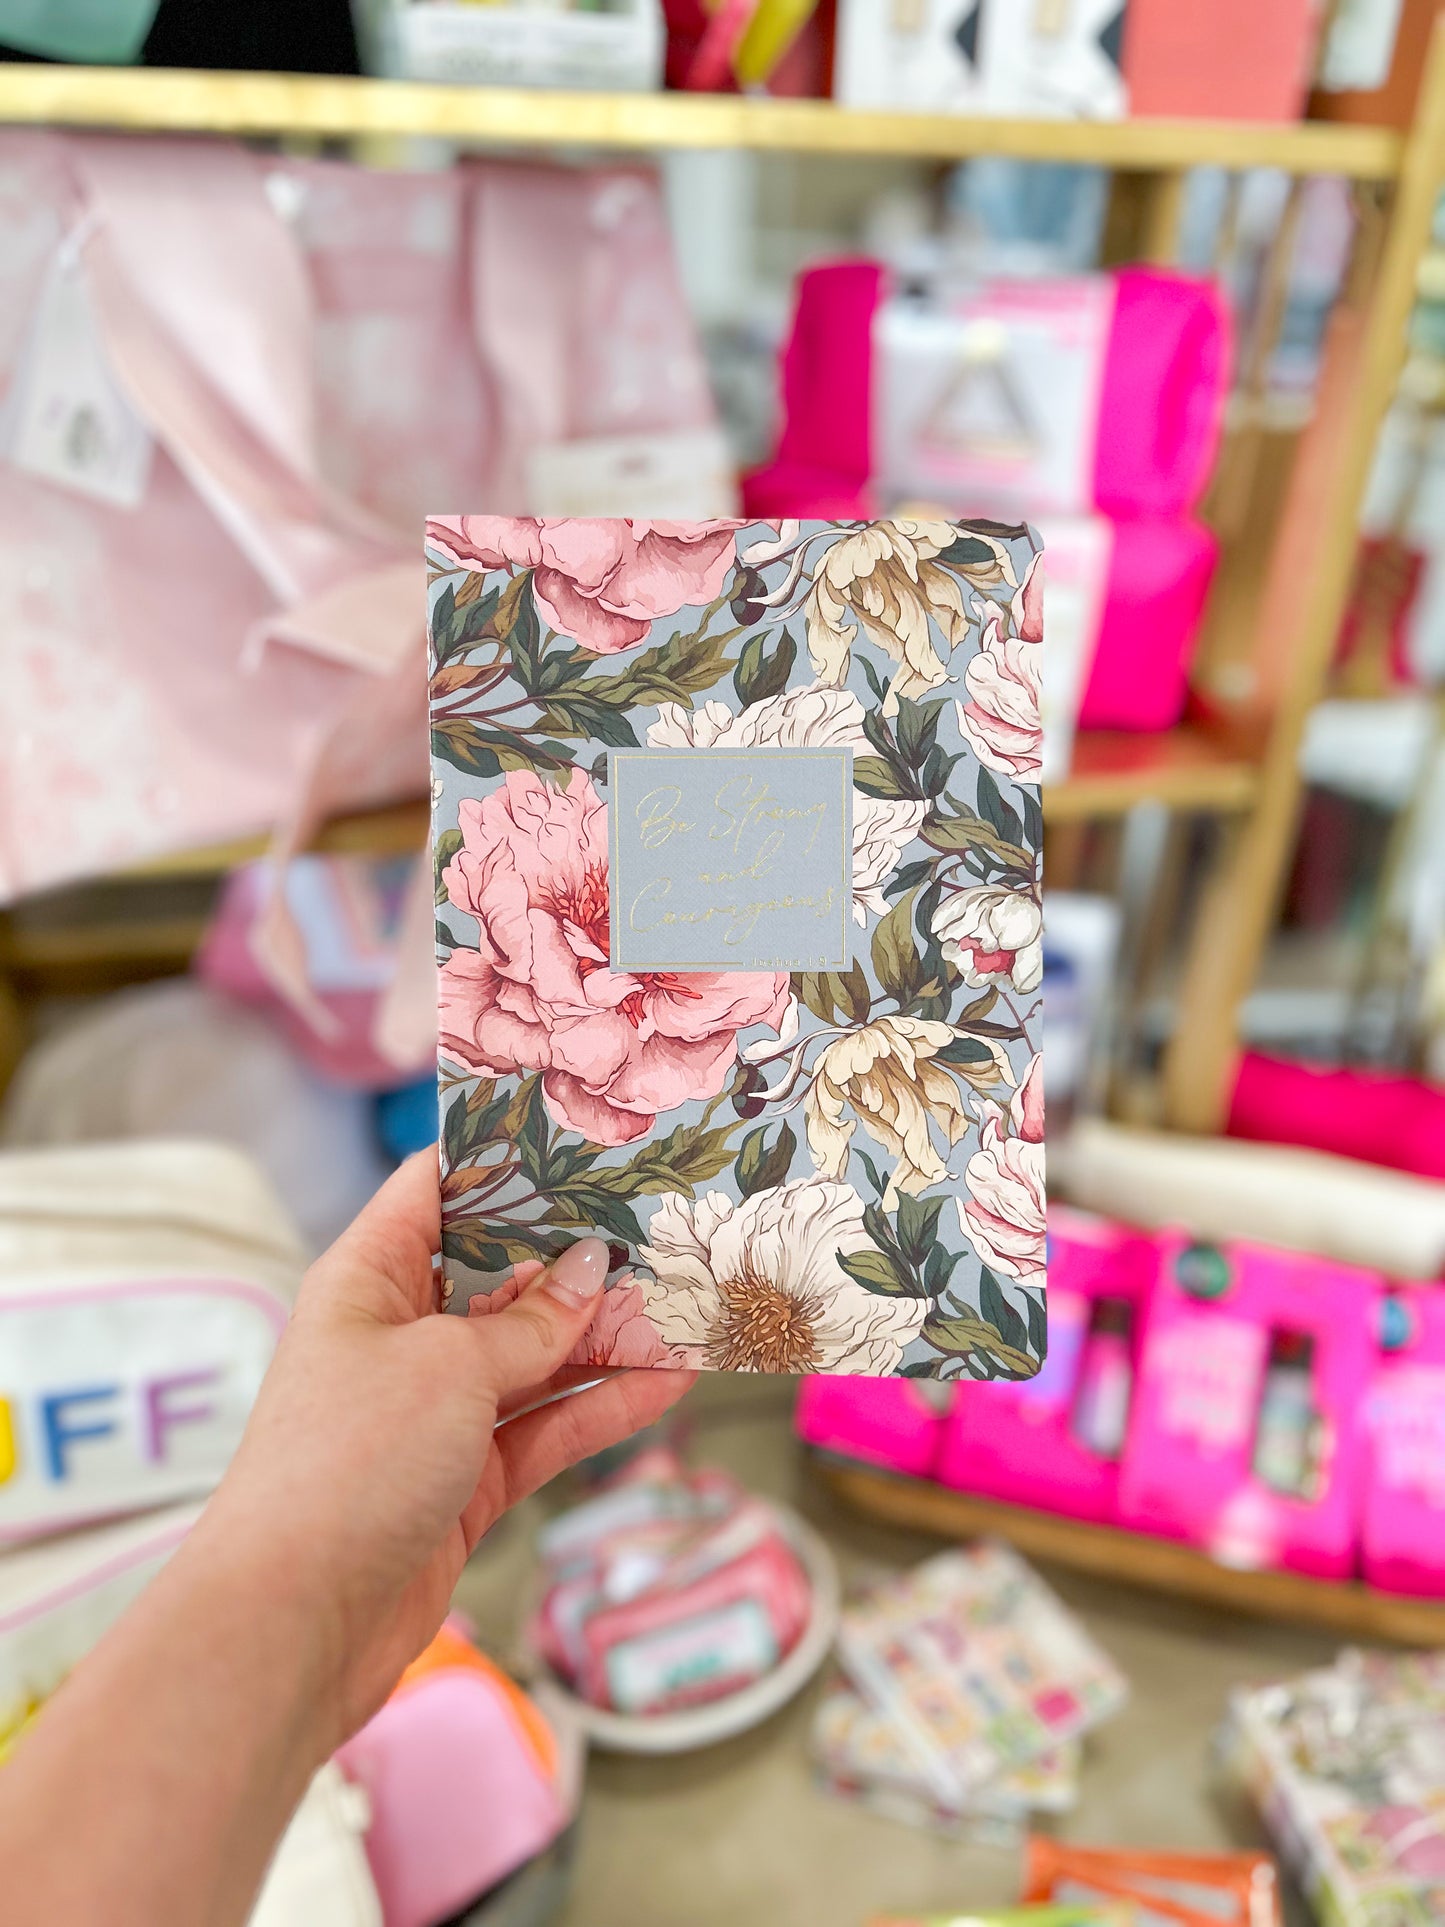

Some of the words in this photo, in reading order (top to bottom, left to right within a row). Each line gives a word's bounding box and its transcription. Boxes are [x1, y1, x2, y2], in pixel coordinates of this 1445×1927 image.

[636, 786, 697, 848] Be
[709, 775, 826, 856] Strong
[700, 830, 784, 885] and
[630, 877, 847, 945] Courageous
[0, 1366, 222, 1485] FF
